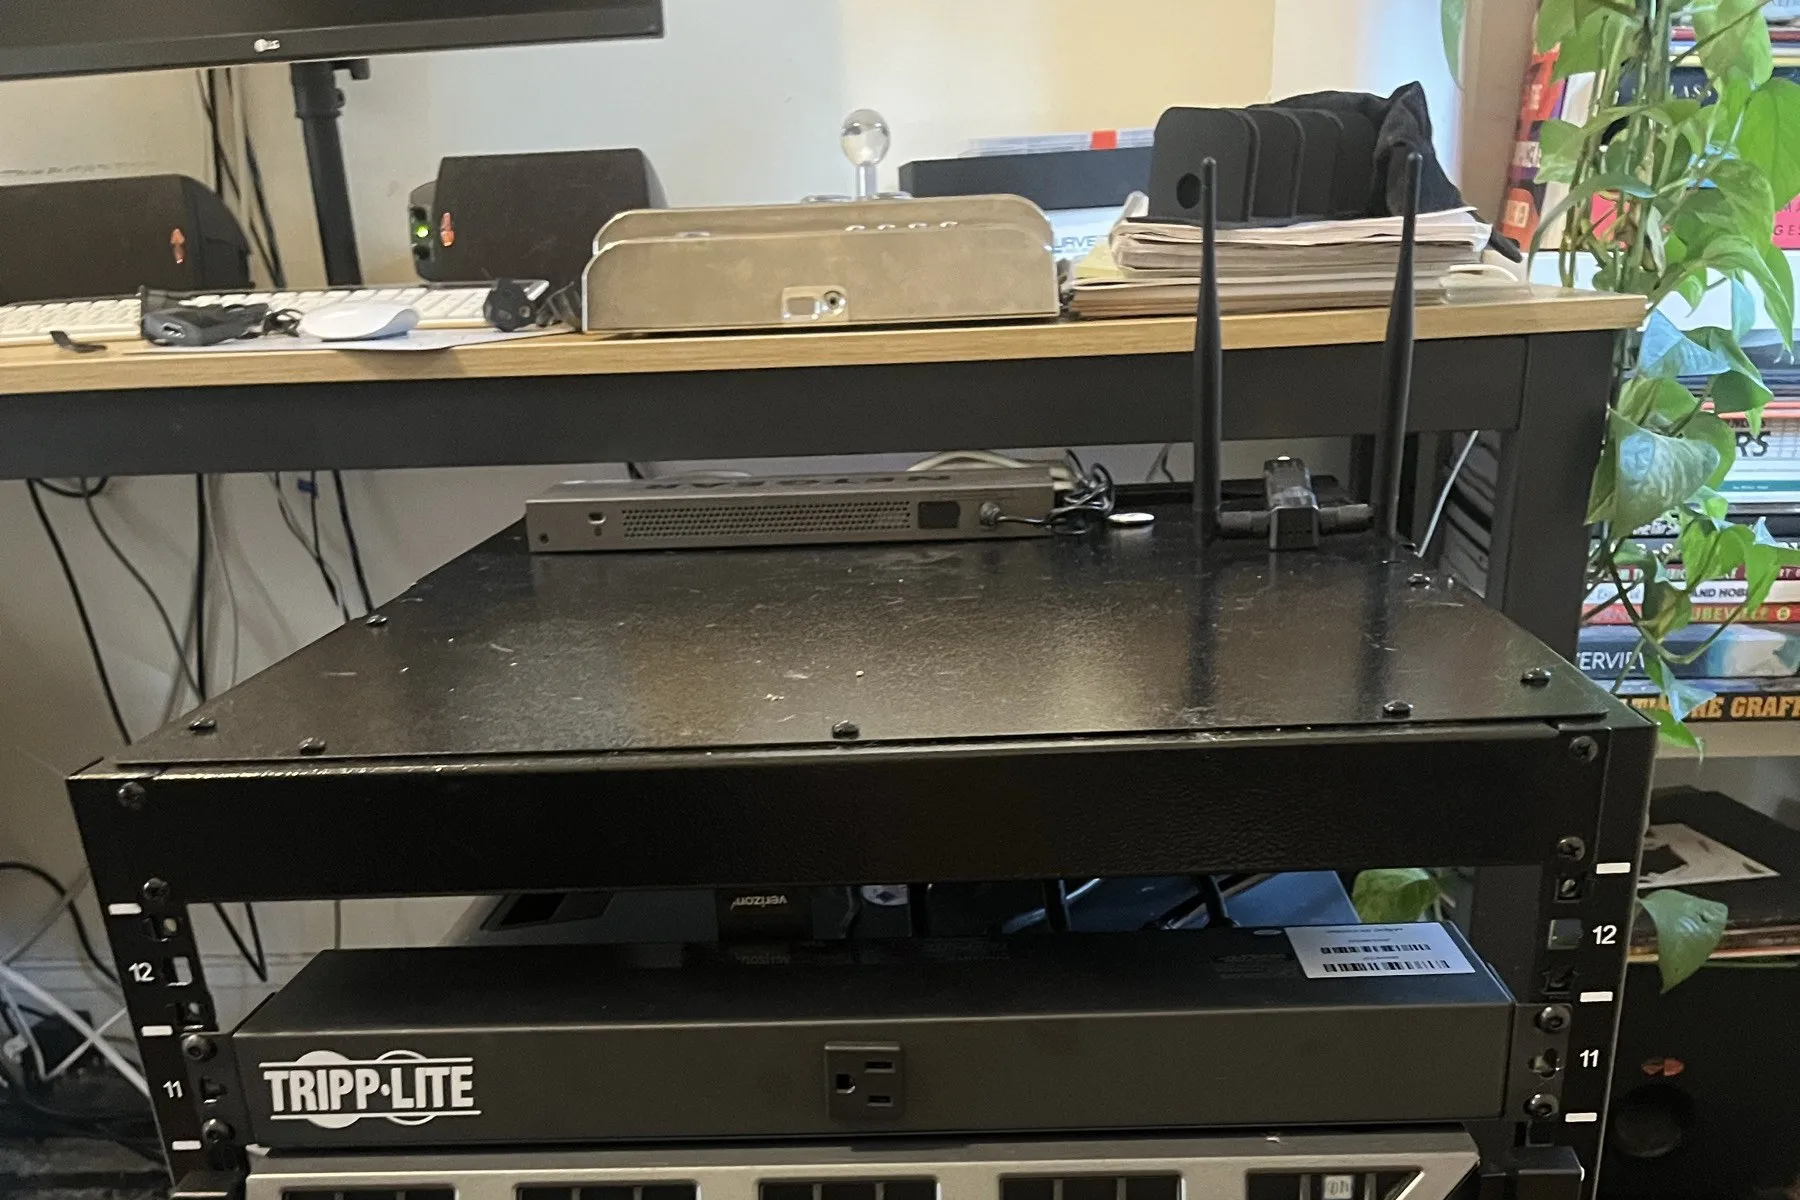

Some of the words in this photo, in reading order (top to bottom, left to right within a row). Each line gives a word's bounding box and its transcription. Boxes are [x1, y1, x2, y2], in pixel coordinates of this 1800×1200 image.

[731, 895, 787, 910] verizon
[1592, 924, 1618, 945] 12
[128, 961, 156, 982] 12
[1579, 1049, 1600, 1068] 11
[162, 1080, 184, 1099] 11
